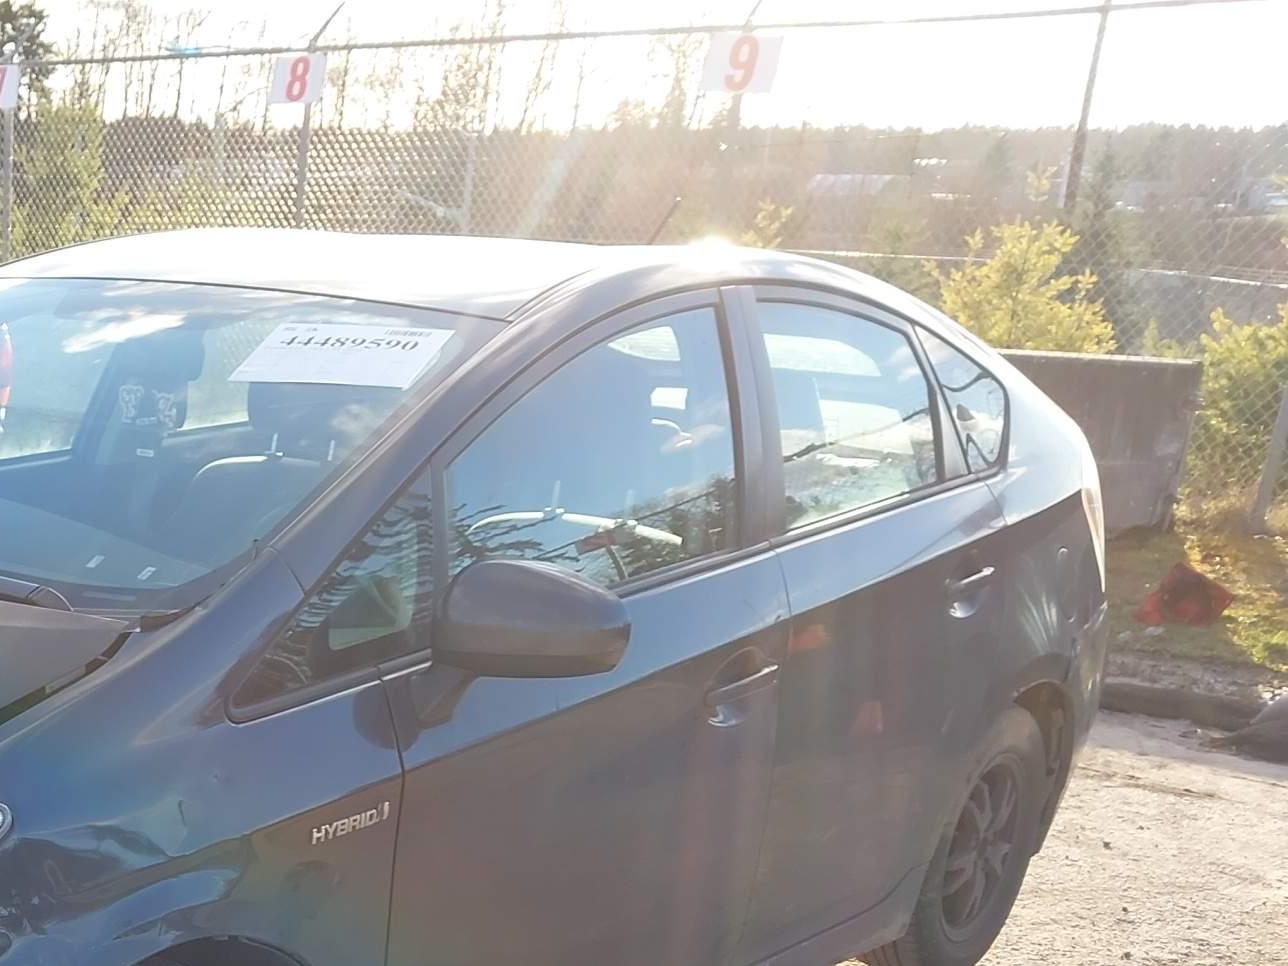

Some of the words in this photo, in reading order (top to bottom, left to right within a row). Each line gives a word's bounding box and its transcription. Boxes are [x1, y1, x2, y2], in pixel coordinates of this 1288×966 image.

[285, 55, 311, 102] 8
[724, 34, 760, 92] 9
[279, 335, 420, 351] 44489590
[311, 808, 378, 845] HYBRID
